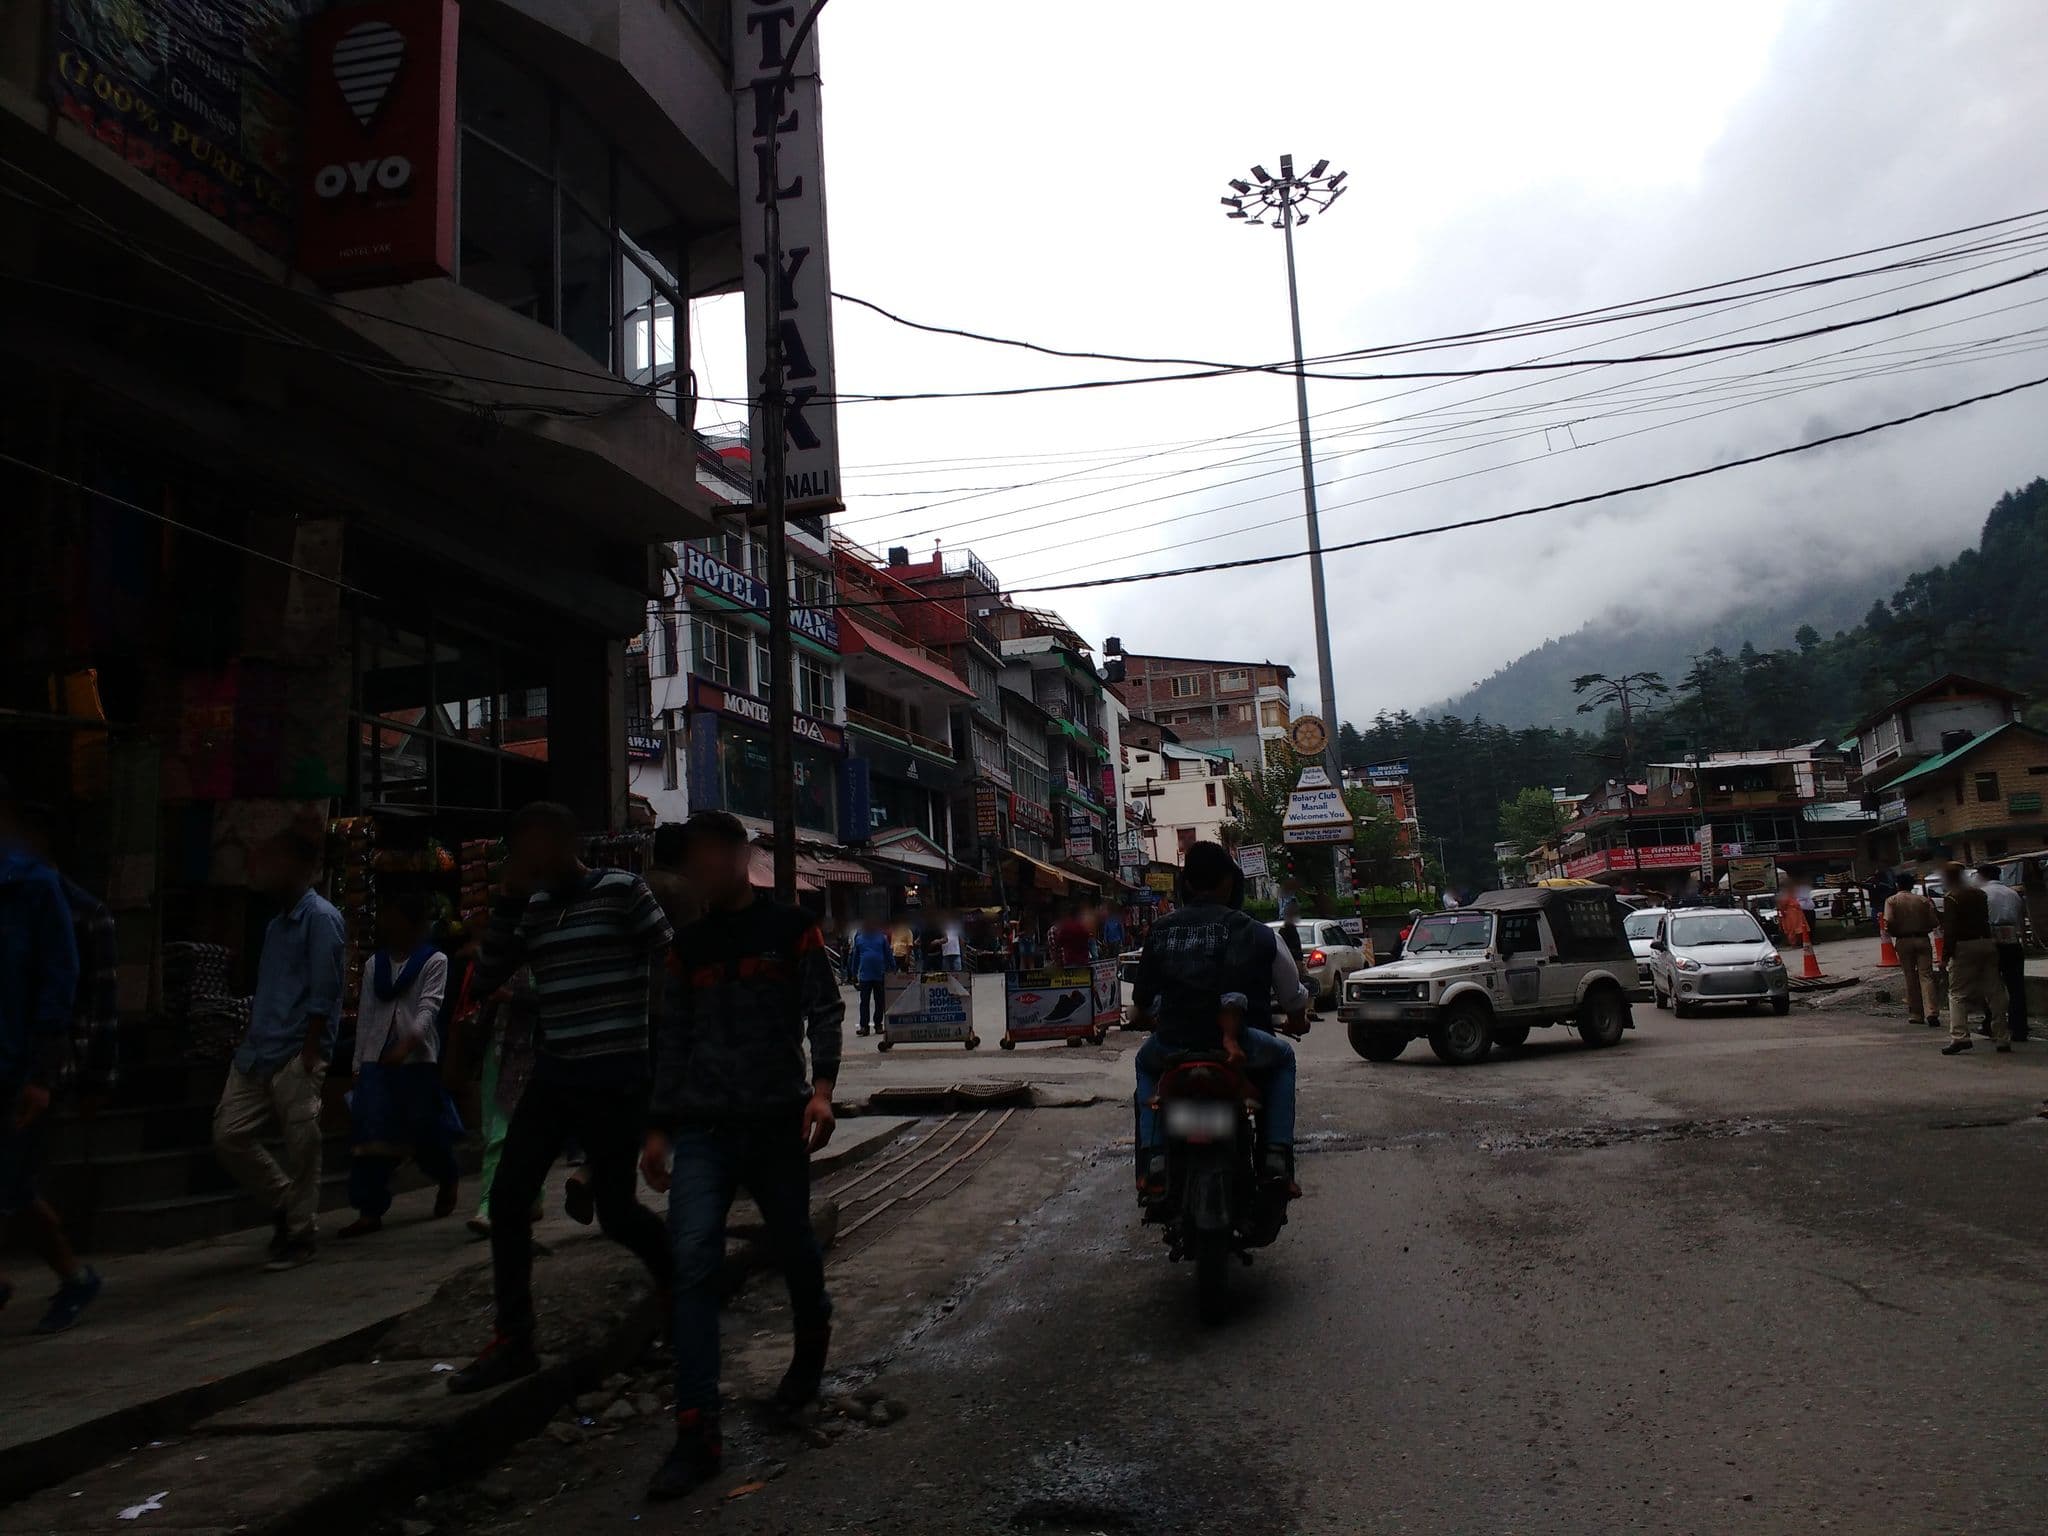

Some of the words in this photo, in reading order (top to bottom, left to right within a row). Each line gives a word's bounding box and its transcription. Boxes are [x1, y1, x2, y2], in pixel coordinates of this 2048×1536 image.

[747, 0, 803, 204] TEL
[314, 155, 411, 198] OYO
[339, 247, 369, 257] HOTEL
[372, 242, 393, 255] YAK
[757, 470, 830, 503] MNALI
[688, 550, 757, 607] HOTEL
[1292, 794, 1317, 803] Rotary
[1318, 792, 1337, 800] Club
[1301, 802, 1328, 811] Manali
[1288, 813, 1329, 821] Welcomes
[1329, 811, 1345, 819] You
